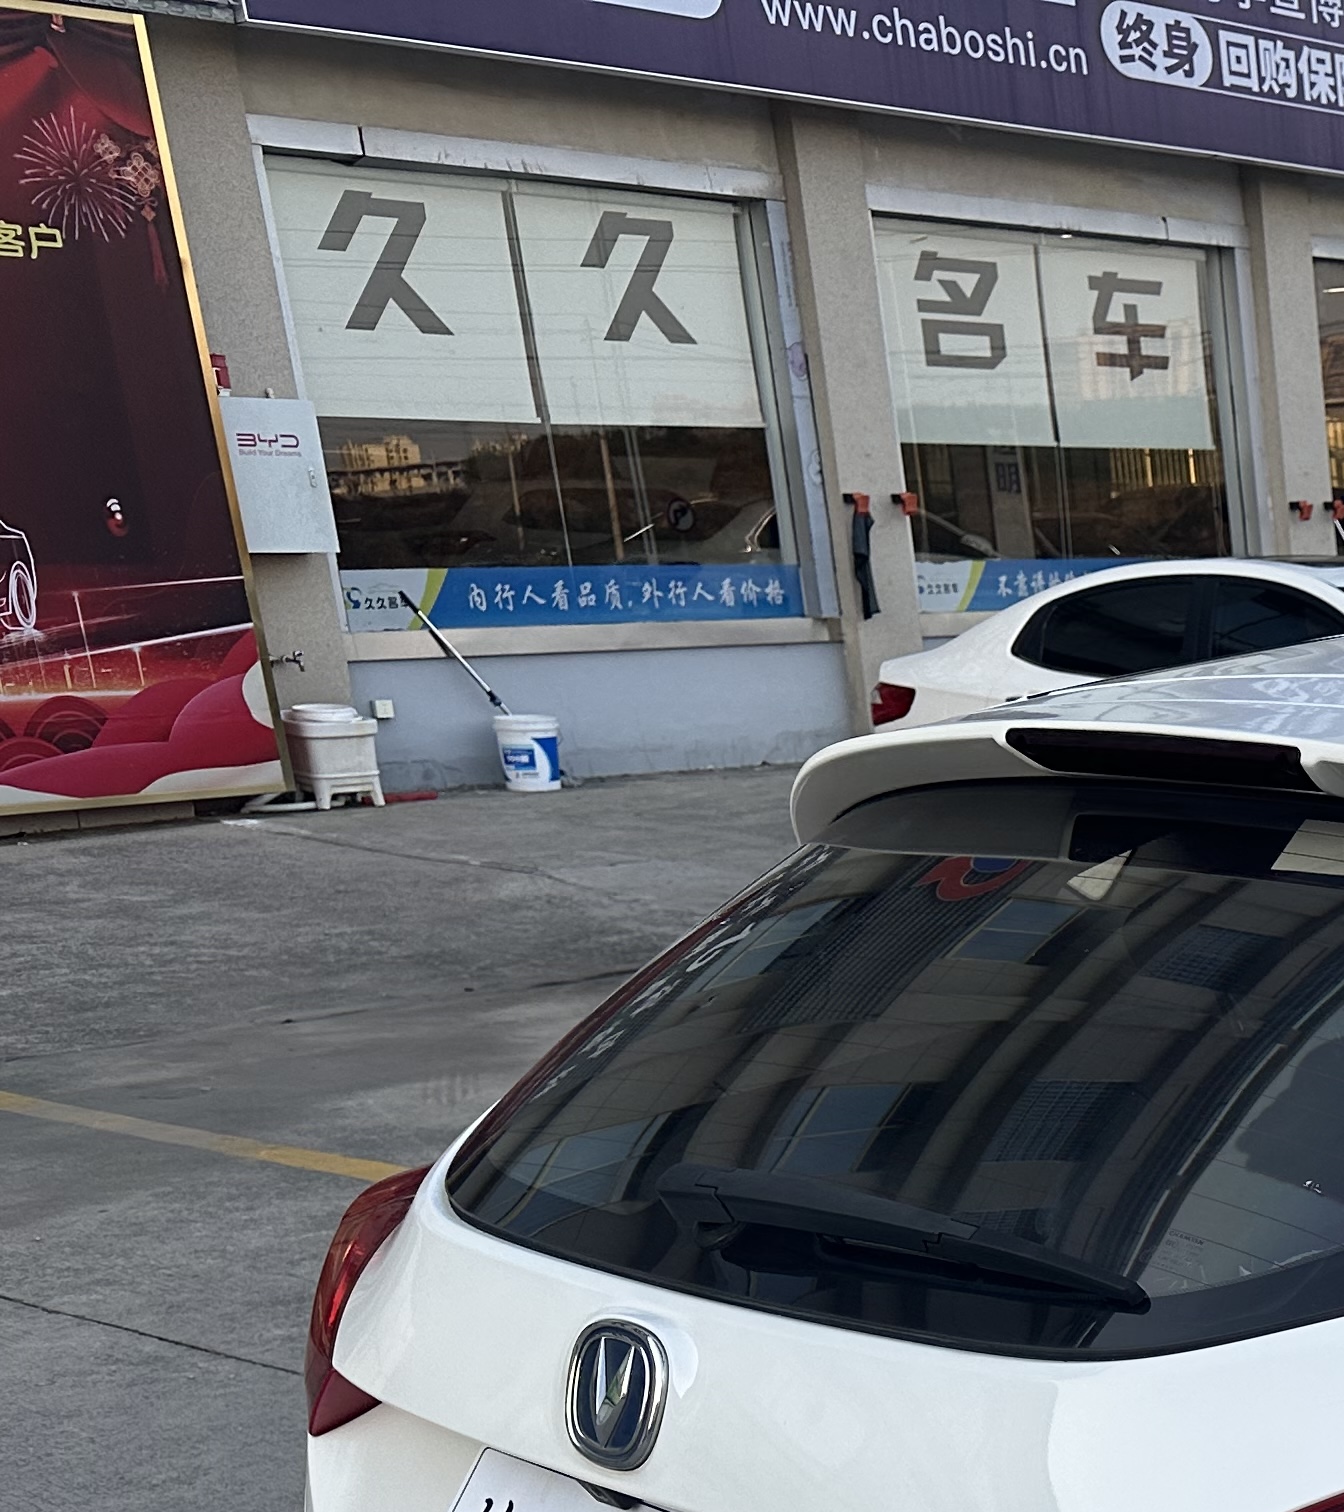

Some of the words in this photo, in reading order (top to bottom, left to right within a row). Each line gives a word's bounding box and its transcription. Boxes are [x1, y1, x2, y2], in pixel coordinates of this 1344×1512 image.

[761, 0, 1089, 75] www.chaboshi.cn
[1115, 9, 1199, 79] 终身
[0, 220, 63, 259] 客户
[317, 189, 698, 345] 久久
[914, 250, 1170, 382] 名车
[236, 433, 300, 449] BYD
[257, 449, 273, 457] Your
